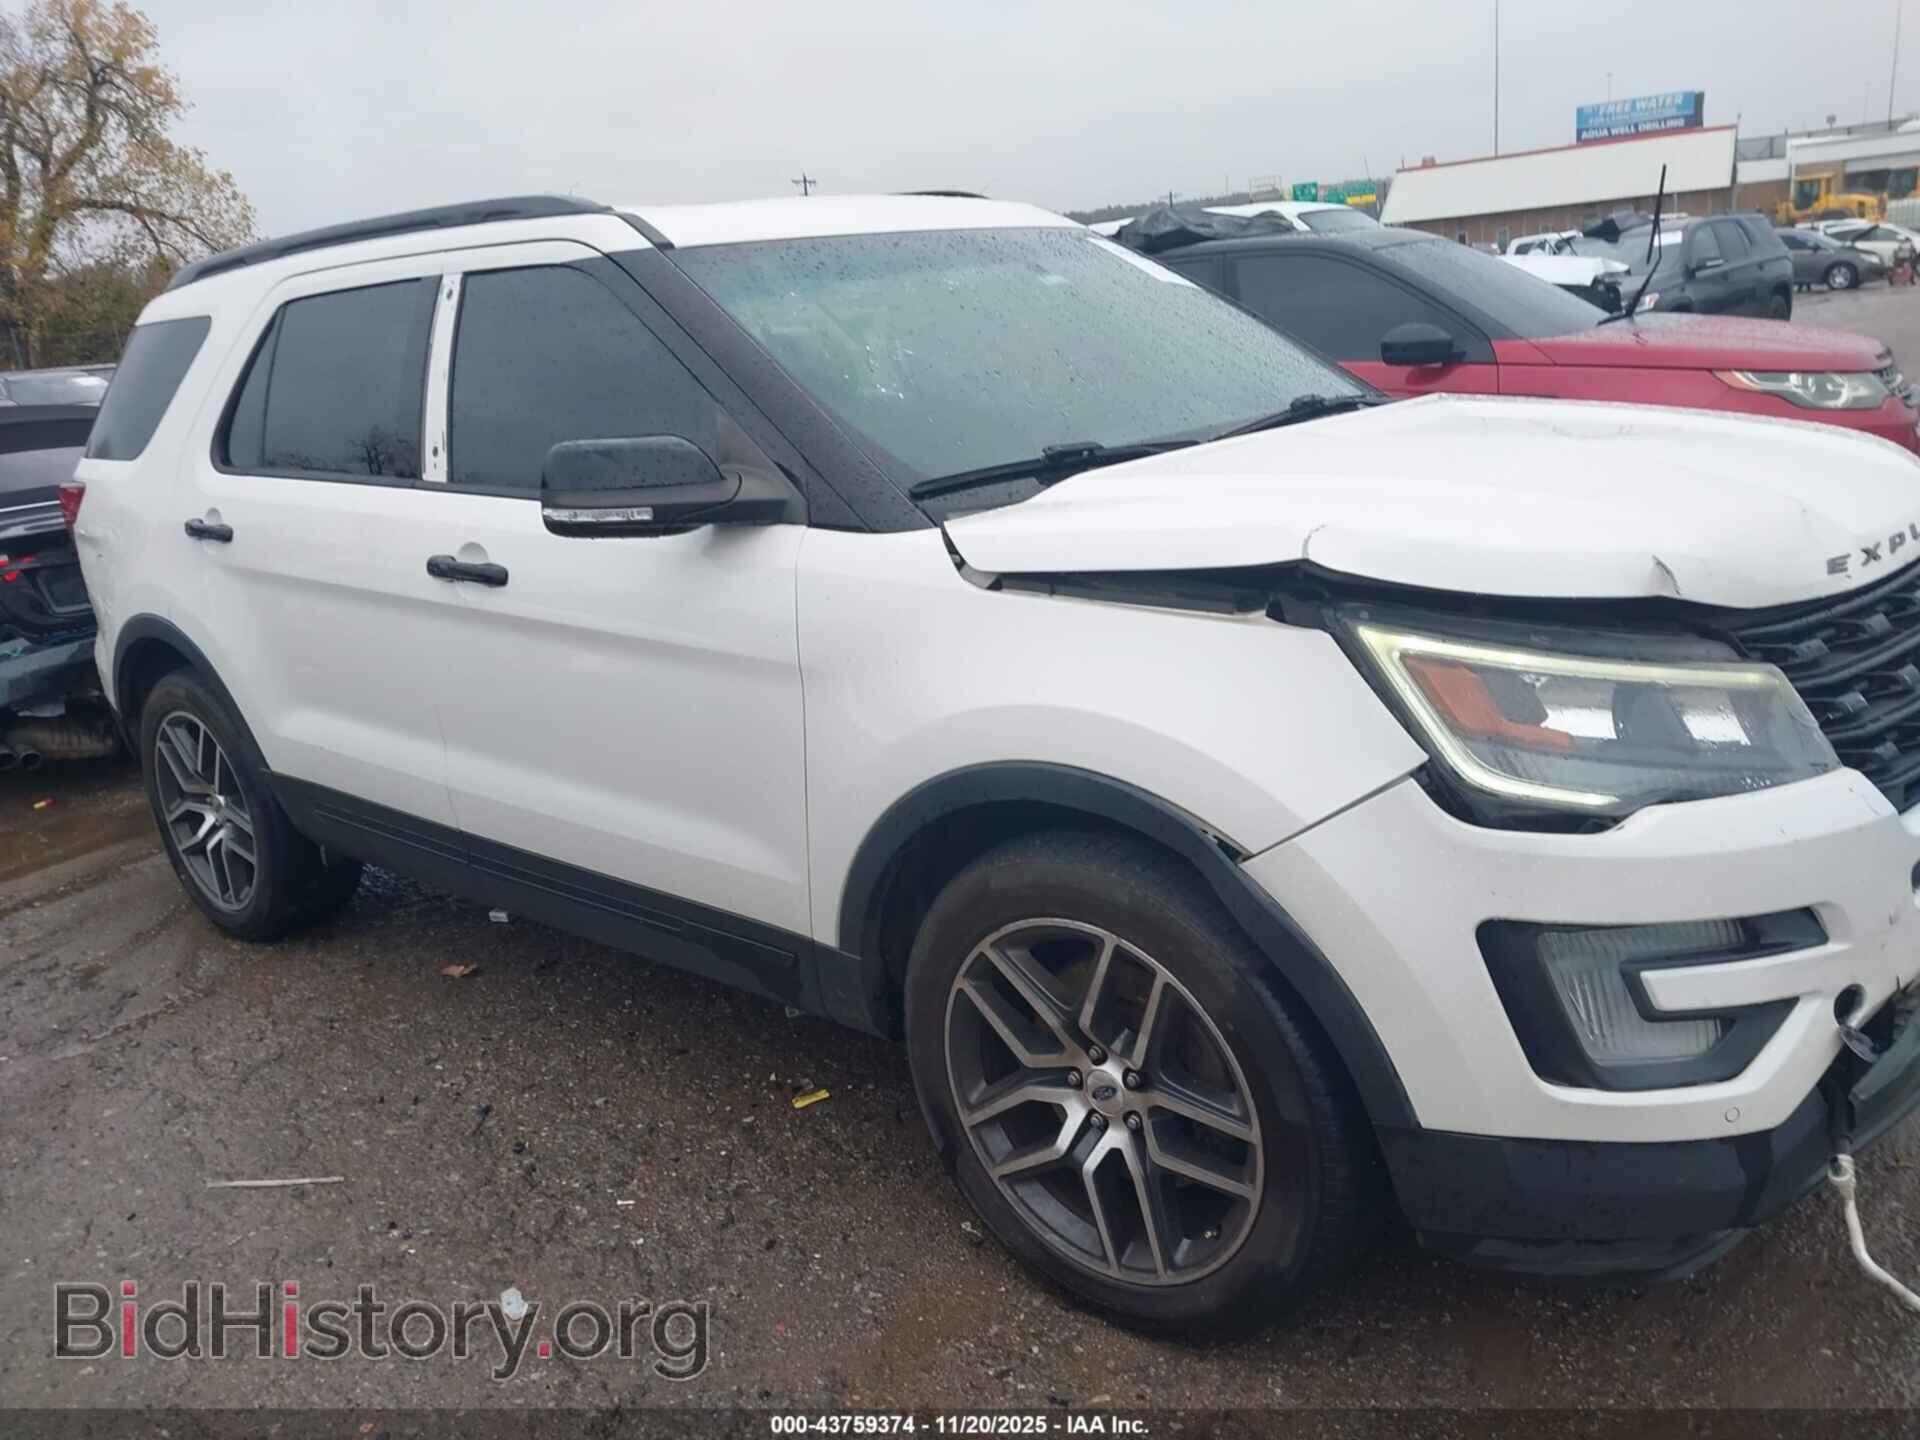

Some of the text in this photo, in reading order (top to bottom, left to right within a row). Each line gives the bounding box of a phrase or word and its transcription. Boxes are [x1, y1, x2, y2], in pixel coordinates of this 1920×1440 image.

[1636, 95, 1683, 111] WATER
[1582, 119, 1685, 139] AQUA WELL DRILLING
